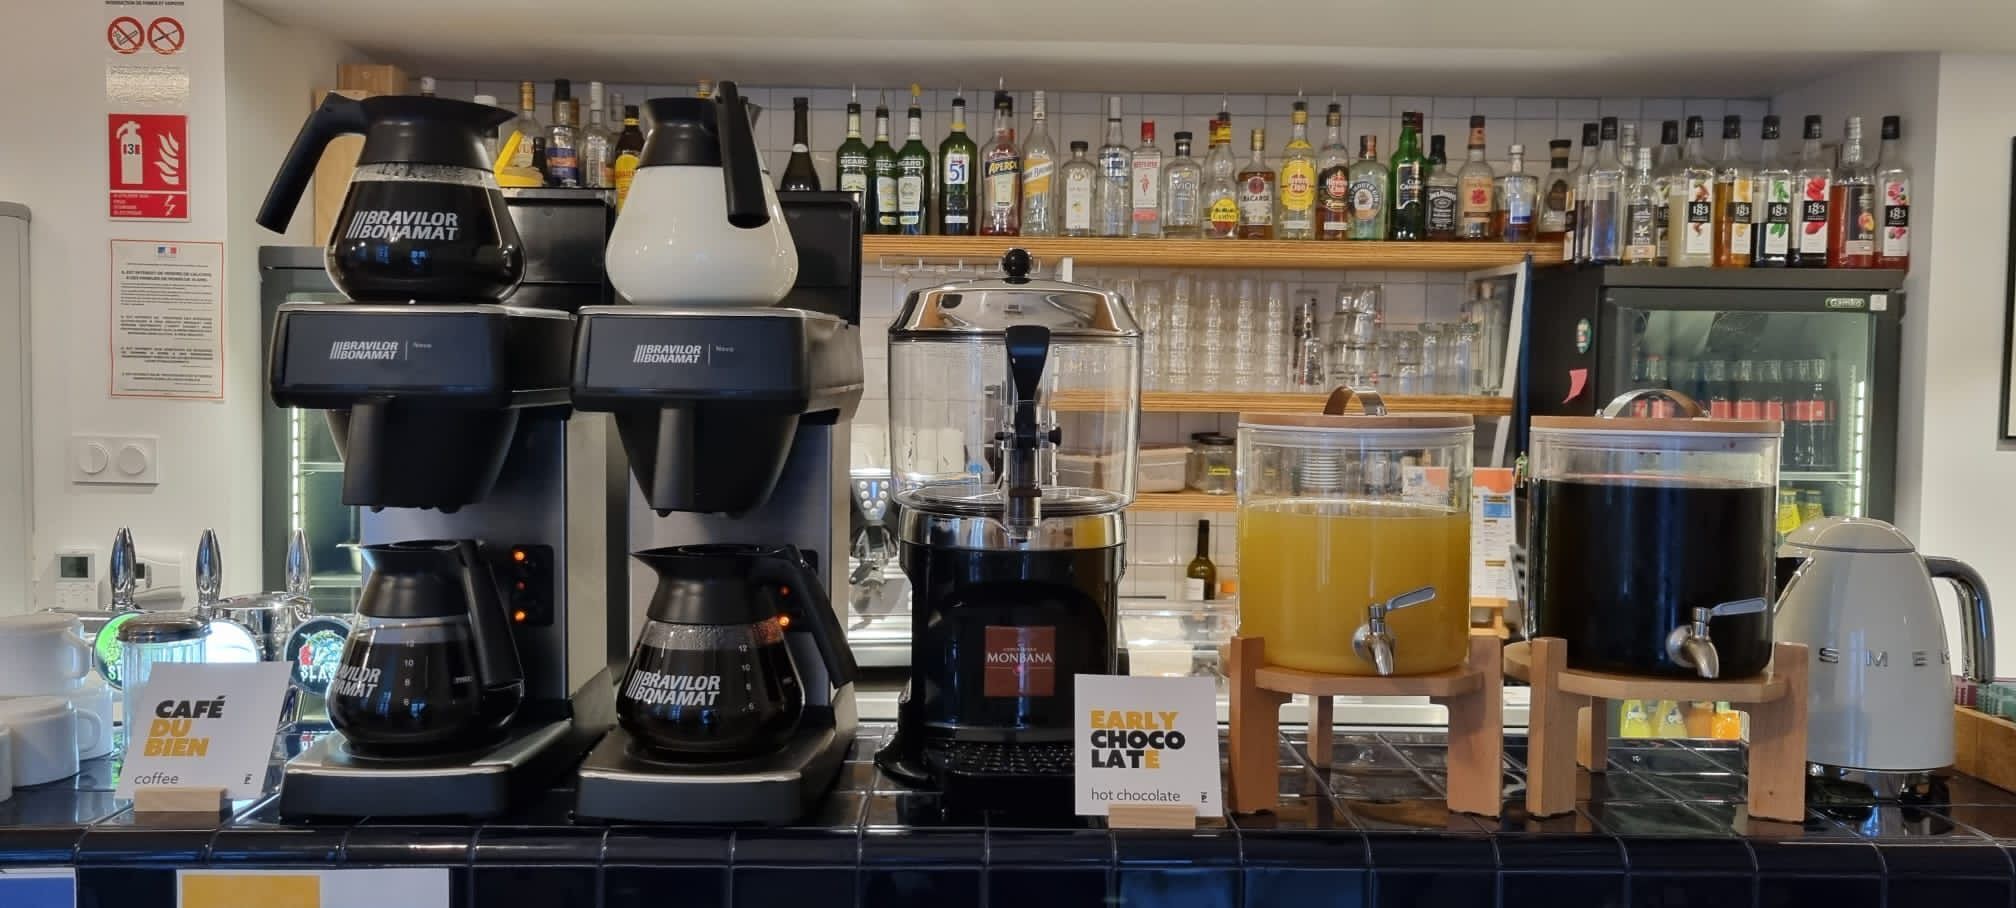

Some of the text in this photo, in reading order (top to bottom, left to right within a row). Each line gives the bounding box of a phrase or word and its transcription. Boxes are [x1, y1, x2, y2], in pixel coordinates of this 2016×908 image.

[949, 164, 965, 182] 51
[367, 210, 458, 227] BRAVILOR
[360, 224, 459, 241] BONAMAT
[342, 341, 399, 351] BRAVILOR
[646, 344, 702, 354] BRAVILOR
[340, 350, 397, 360] BONAMAT
[643, 354, 700, 364] BONAMAT
[738, 644, 748, 653] 12
[404, 659, 414, 668] 10
[986, 653, 1054, 664] MONBANA
[741, 663, 751, 672] 10
[641, 671, 721, 691] BRAVILOR
[634, 687, 720, 706] BONAMAT
[155, 696, 226, 719] CAFÉ
[748, 702, 755, 711] 6
[1090, 710, 1179, 730] EARLY
[149, 719, 193, 738] DU
[143, 737, 209, 758] BIEN
[1090, 730, 1186, 750] CHOCO
[1091, 749, 1161, 769] LATE
[134, 771, 179, 785] coffee
[1091, 787, 1181, 802] hot chocolate
